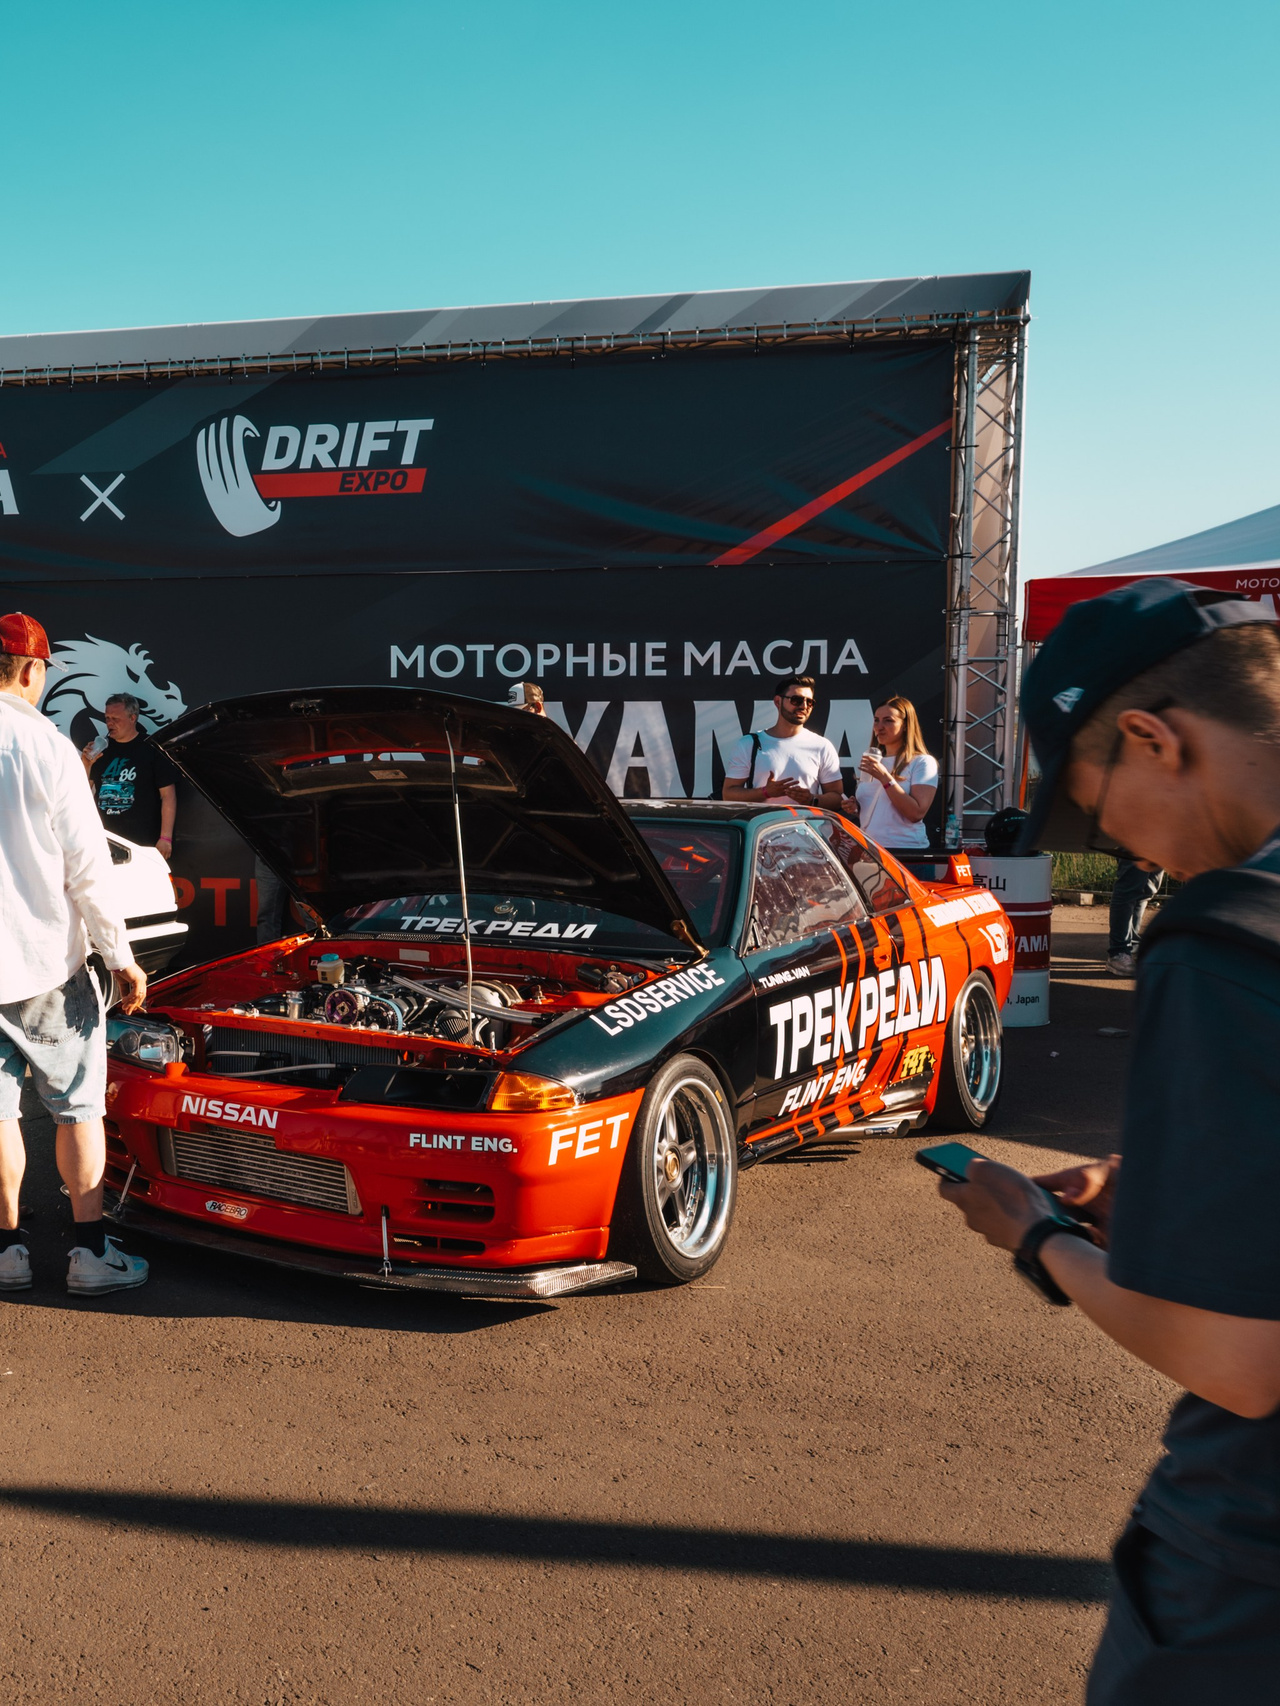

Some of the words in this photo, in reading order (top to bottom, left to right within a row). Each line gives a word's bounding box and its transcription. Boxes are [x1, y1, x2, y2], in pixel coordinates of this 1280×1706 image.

[261, 418, 435, 471] DRIFT
[338, 470, 408, 493] EXPO
[389, 642, 668, 679] МОТОРНЫЕ
[683, 639, 869, 676] МАСЛА
[119, 766, 136, 782] 86
[955, 865, 971, 877] FET
[401, 916, 485, 934] ТРЕК
[483, 920, 598, 939] РЕДИ
[589, 962, 725, 1036] LSDSERVICE
[1015, 994, 1040, 1006] Japan
[769, 982, 854, 1080] ТРЕК
[858, 956, 946, 1050] РЕДИ
[778, 1071, 834, 1117] FLINT
[181, 1095, 279, 1130] NISSAN
[409, 1133, 465, 1152] FLINT
[471, 1136, 518, 1153] ENG.
[548, 1112, 629, 1166] FET
[209, 1201, 248, 1217] RACEBRO
